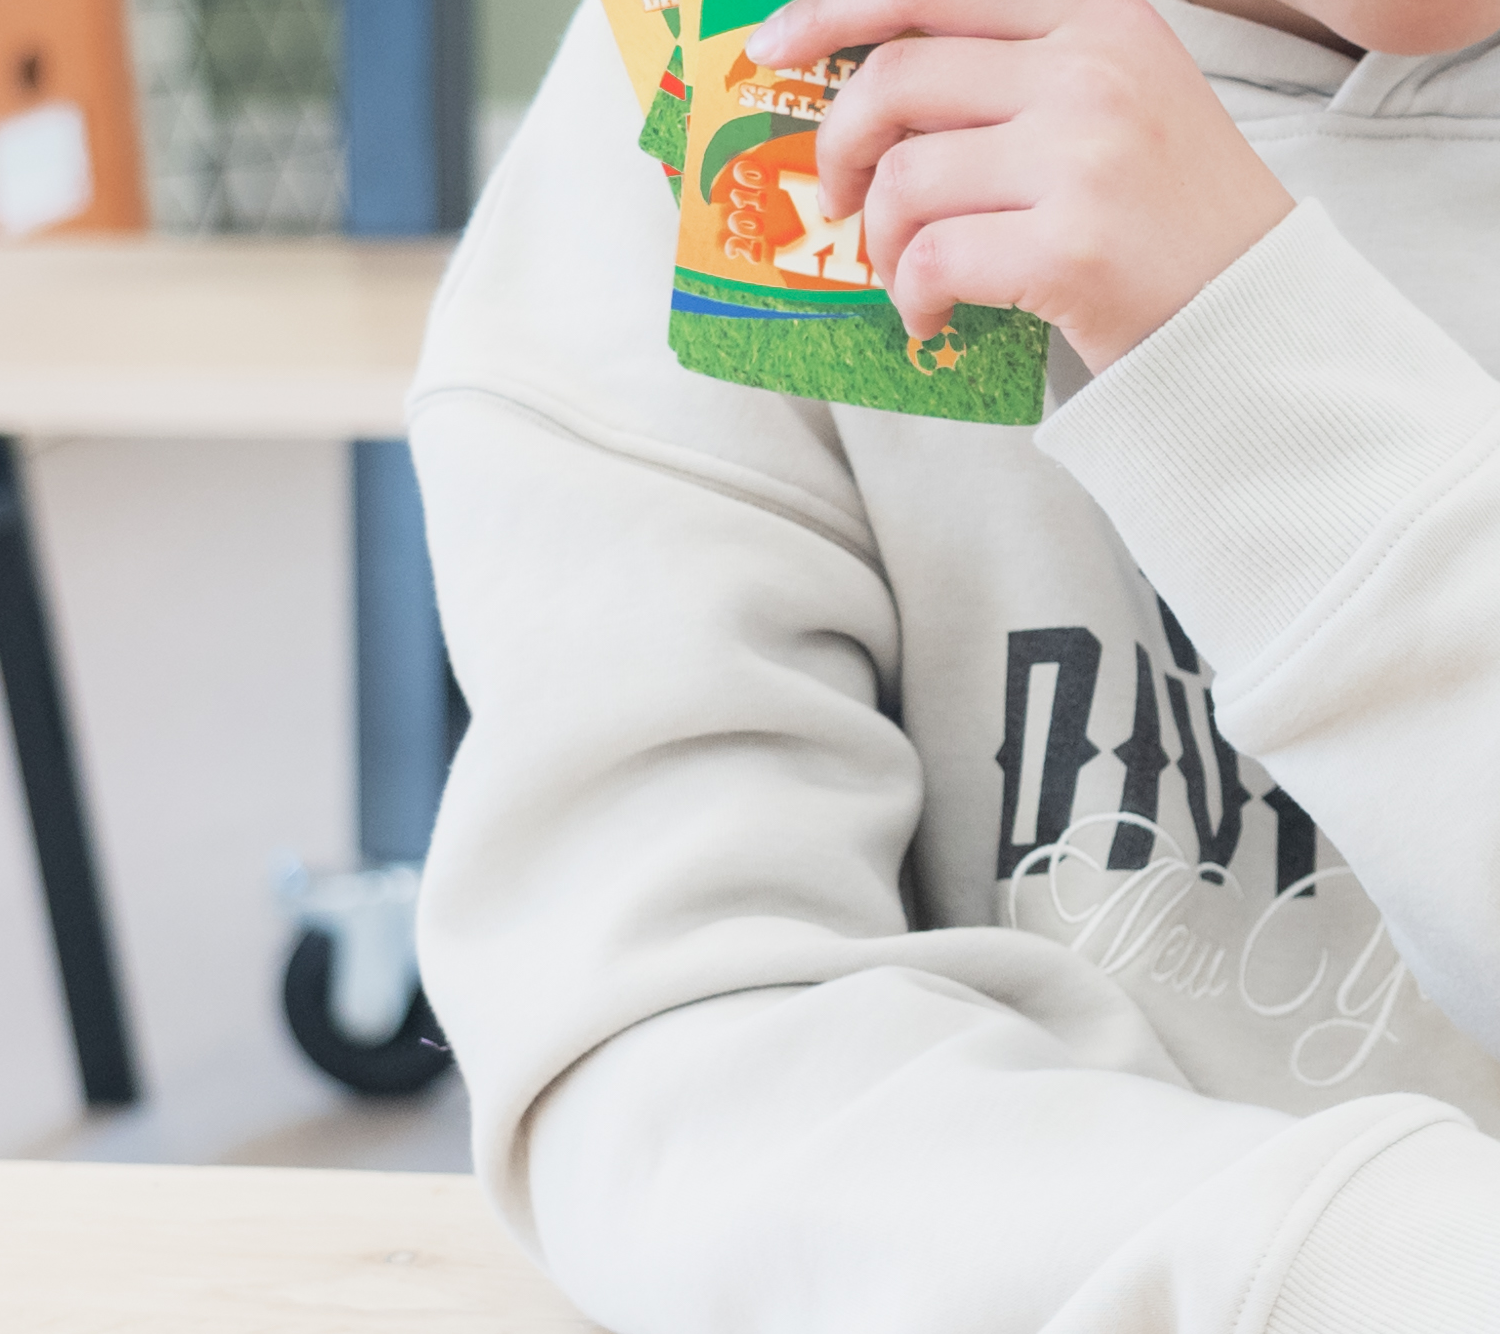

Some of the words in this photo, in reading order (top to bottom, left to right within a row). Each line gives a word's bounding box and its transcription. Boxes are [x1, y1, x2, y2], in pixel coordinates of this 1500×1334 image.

[737, 82, 835, 123] ETJES
[724, 159, 767, 265] 2010
[773, 169, 886, 288] K
